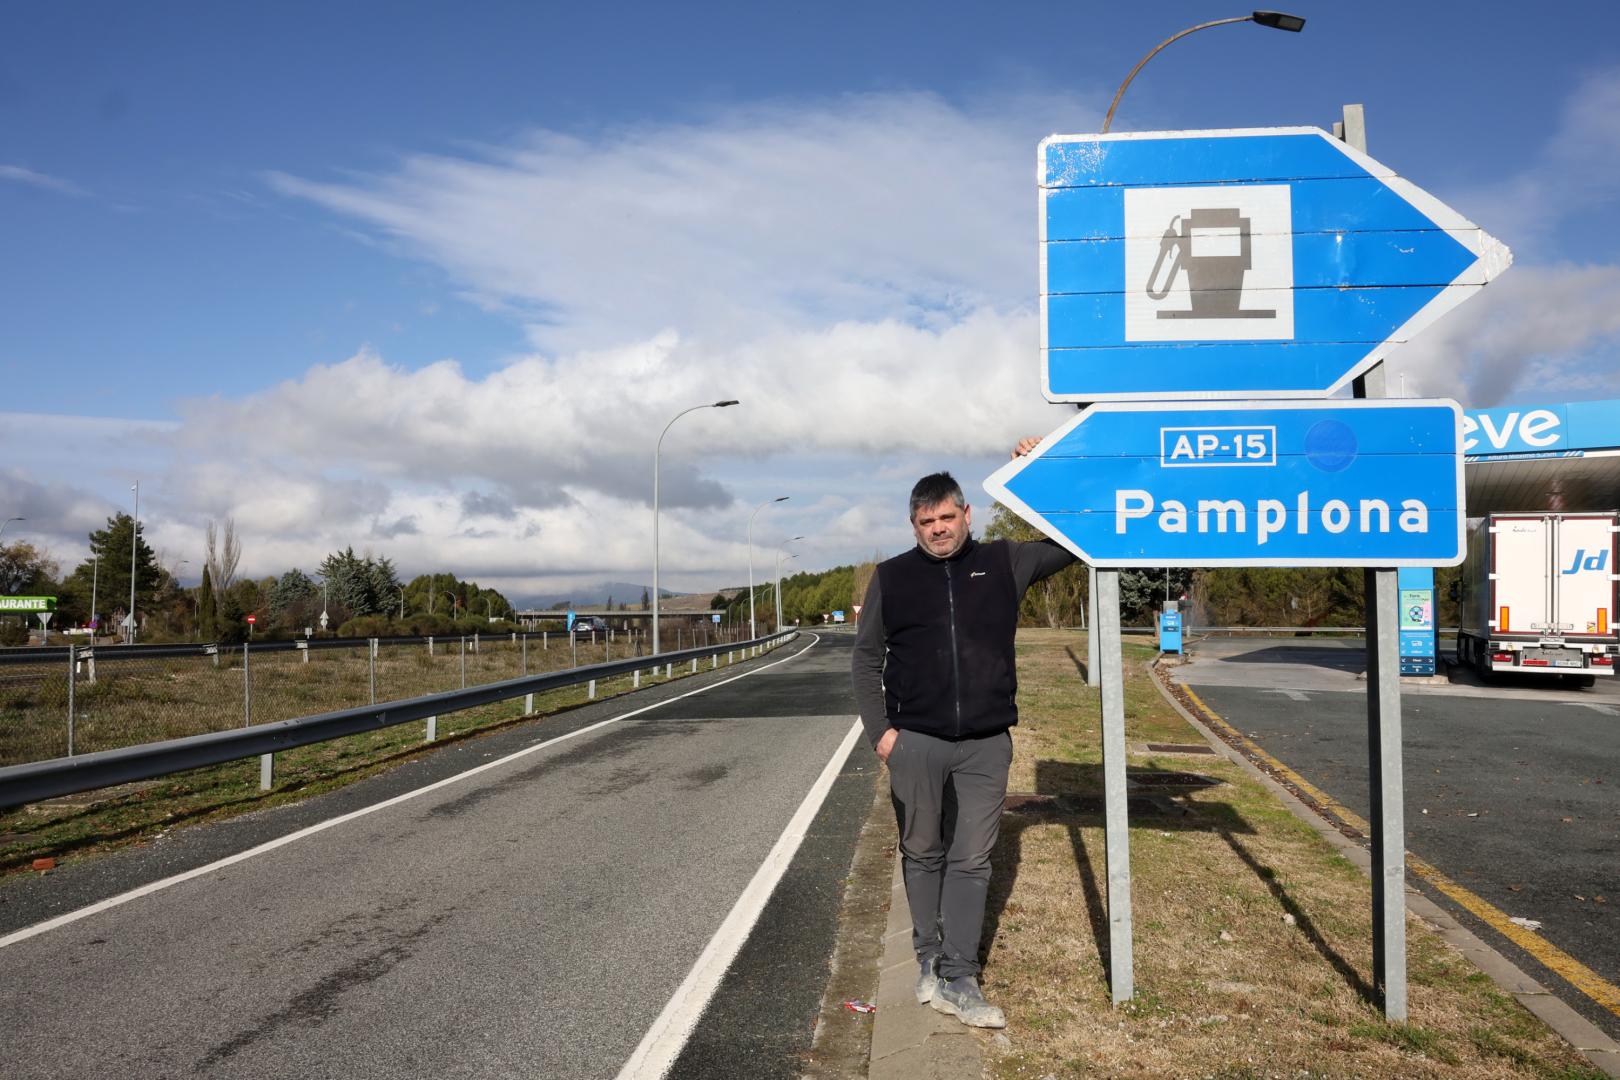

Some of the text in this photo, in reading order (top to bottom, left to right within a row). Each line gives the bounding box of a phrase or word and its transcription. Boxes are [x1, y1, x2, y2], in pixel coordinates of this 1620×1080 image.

[1170, 434, 1267, 460] AP-15
[1115, 489, 1429, 545] Pamplona
[1562, 549, 1609, 575] Jd
[0, 599, 46, 609] URANTE
